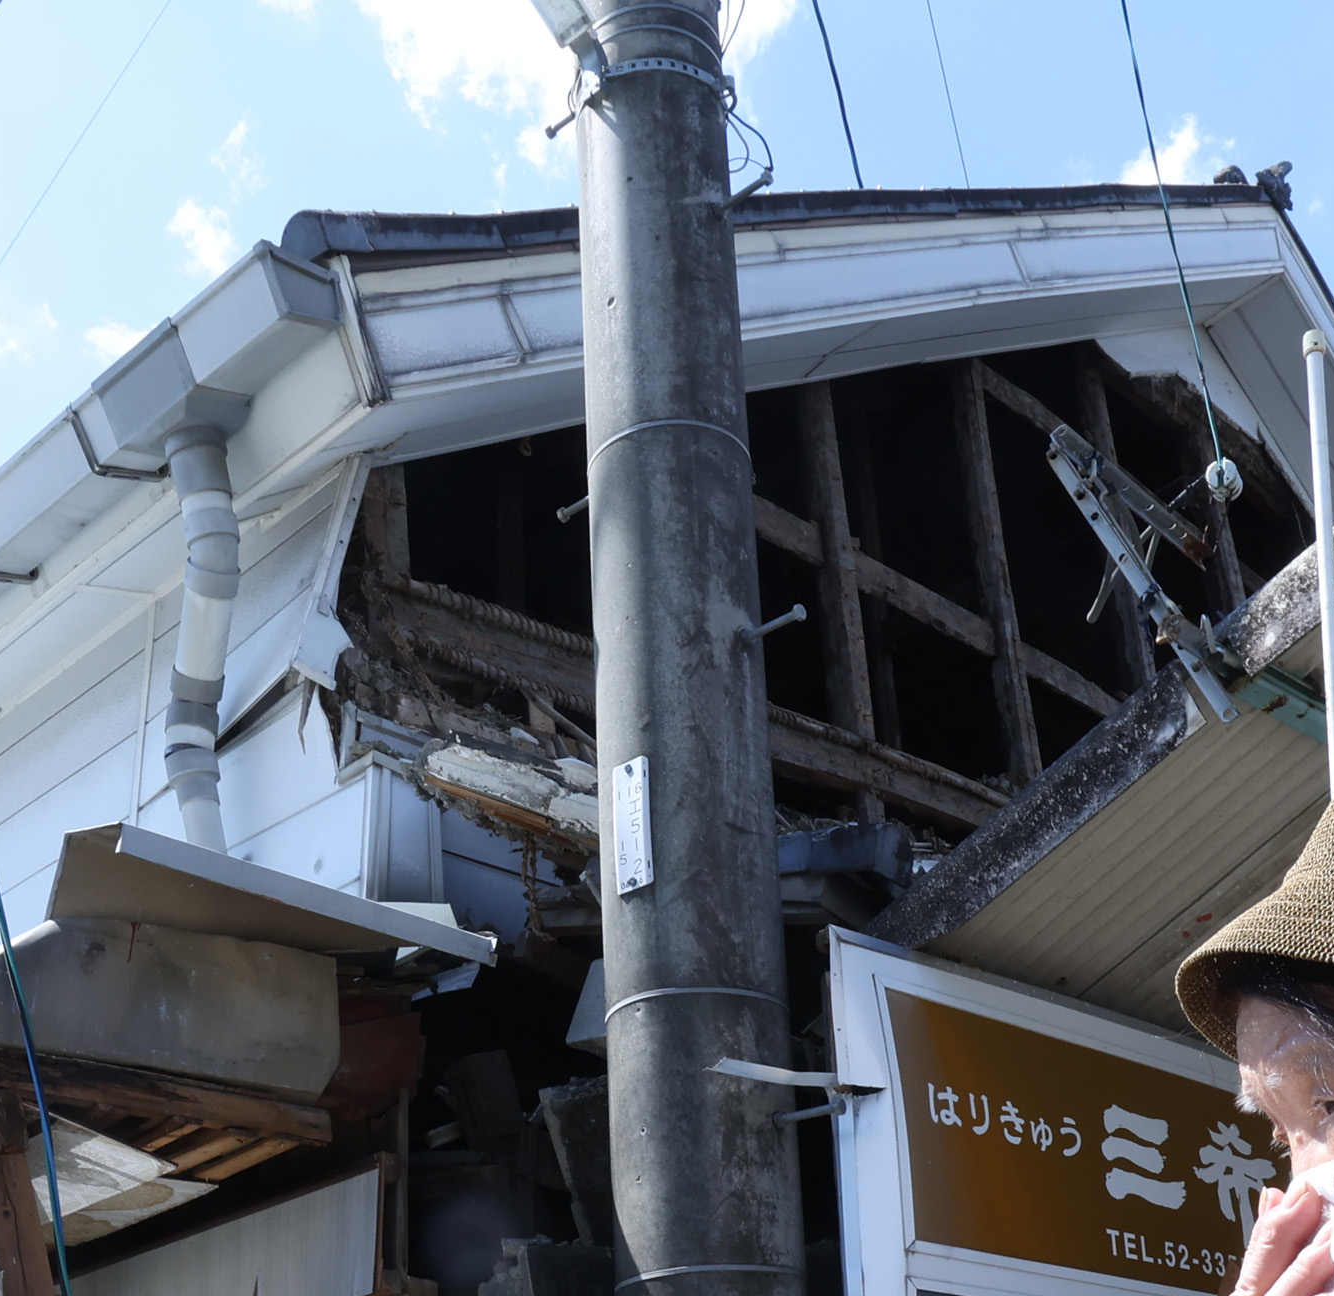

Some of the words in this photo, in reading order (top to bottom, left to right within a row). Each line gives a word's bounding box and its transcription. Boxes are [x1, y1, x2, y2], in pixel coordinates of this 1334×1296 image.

[927, 1082, 1082, 1157] はりきゅう
